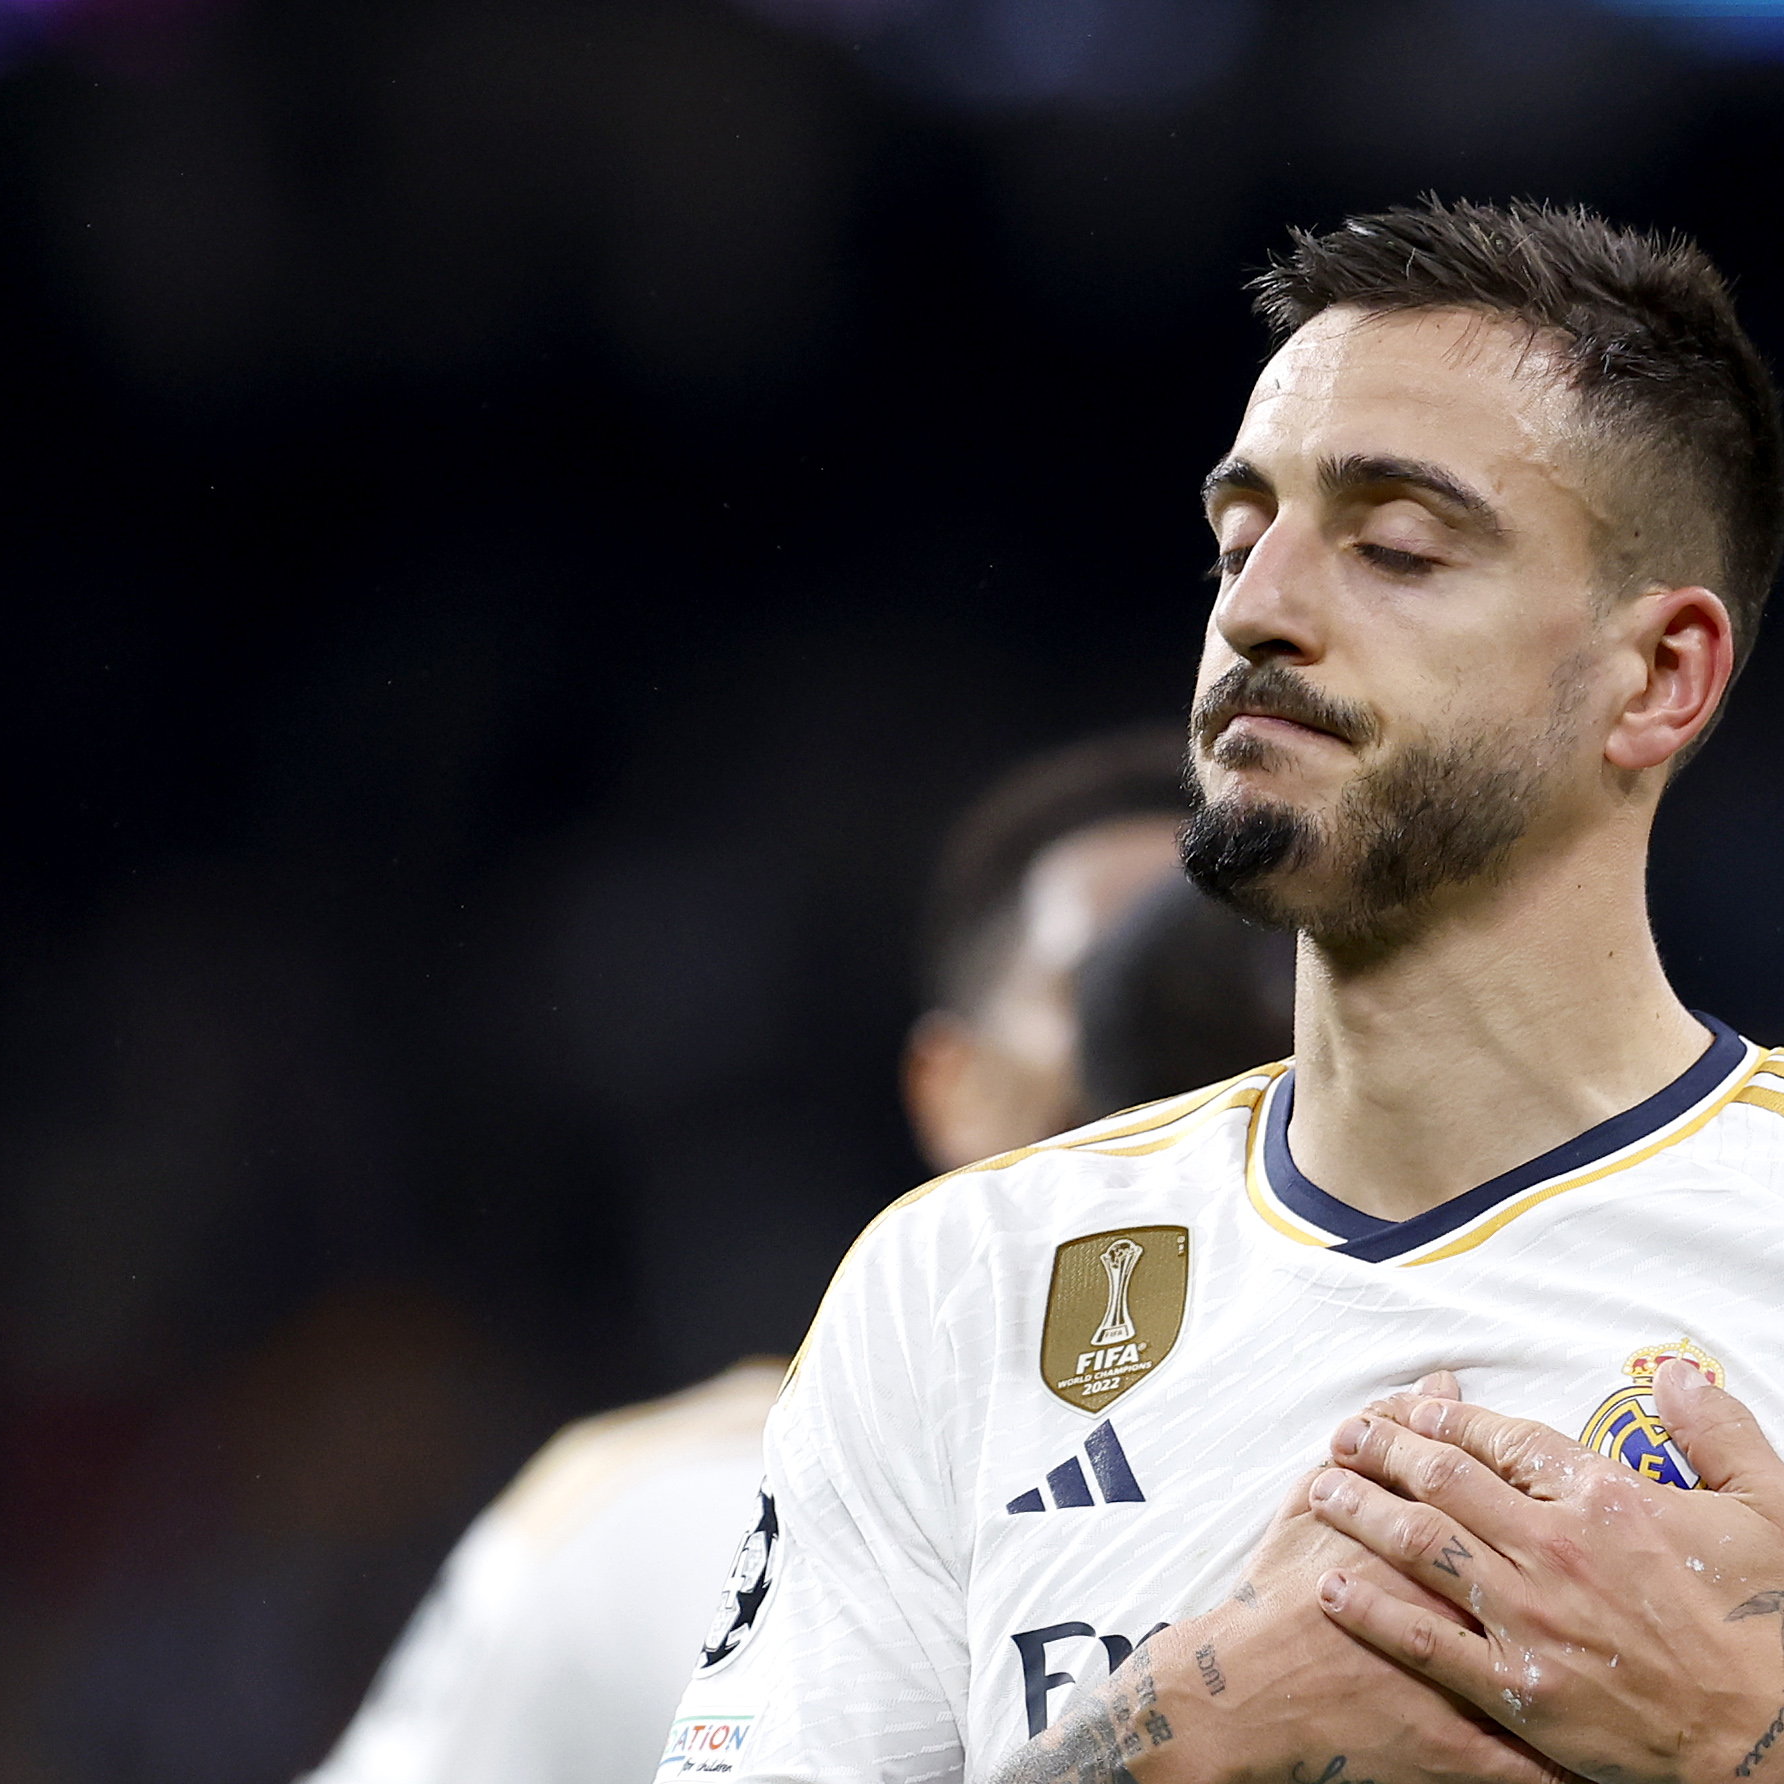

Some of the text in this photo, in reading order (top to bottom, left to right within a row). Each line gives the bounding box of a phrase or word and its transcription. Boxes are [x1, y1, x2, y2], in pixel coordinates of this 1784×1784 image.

[1057, 1360, 1153, 1389] WORLD CHAMPIONS
[1082, 1377, 1121, 1396] 2022
